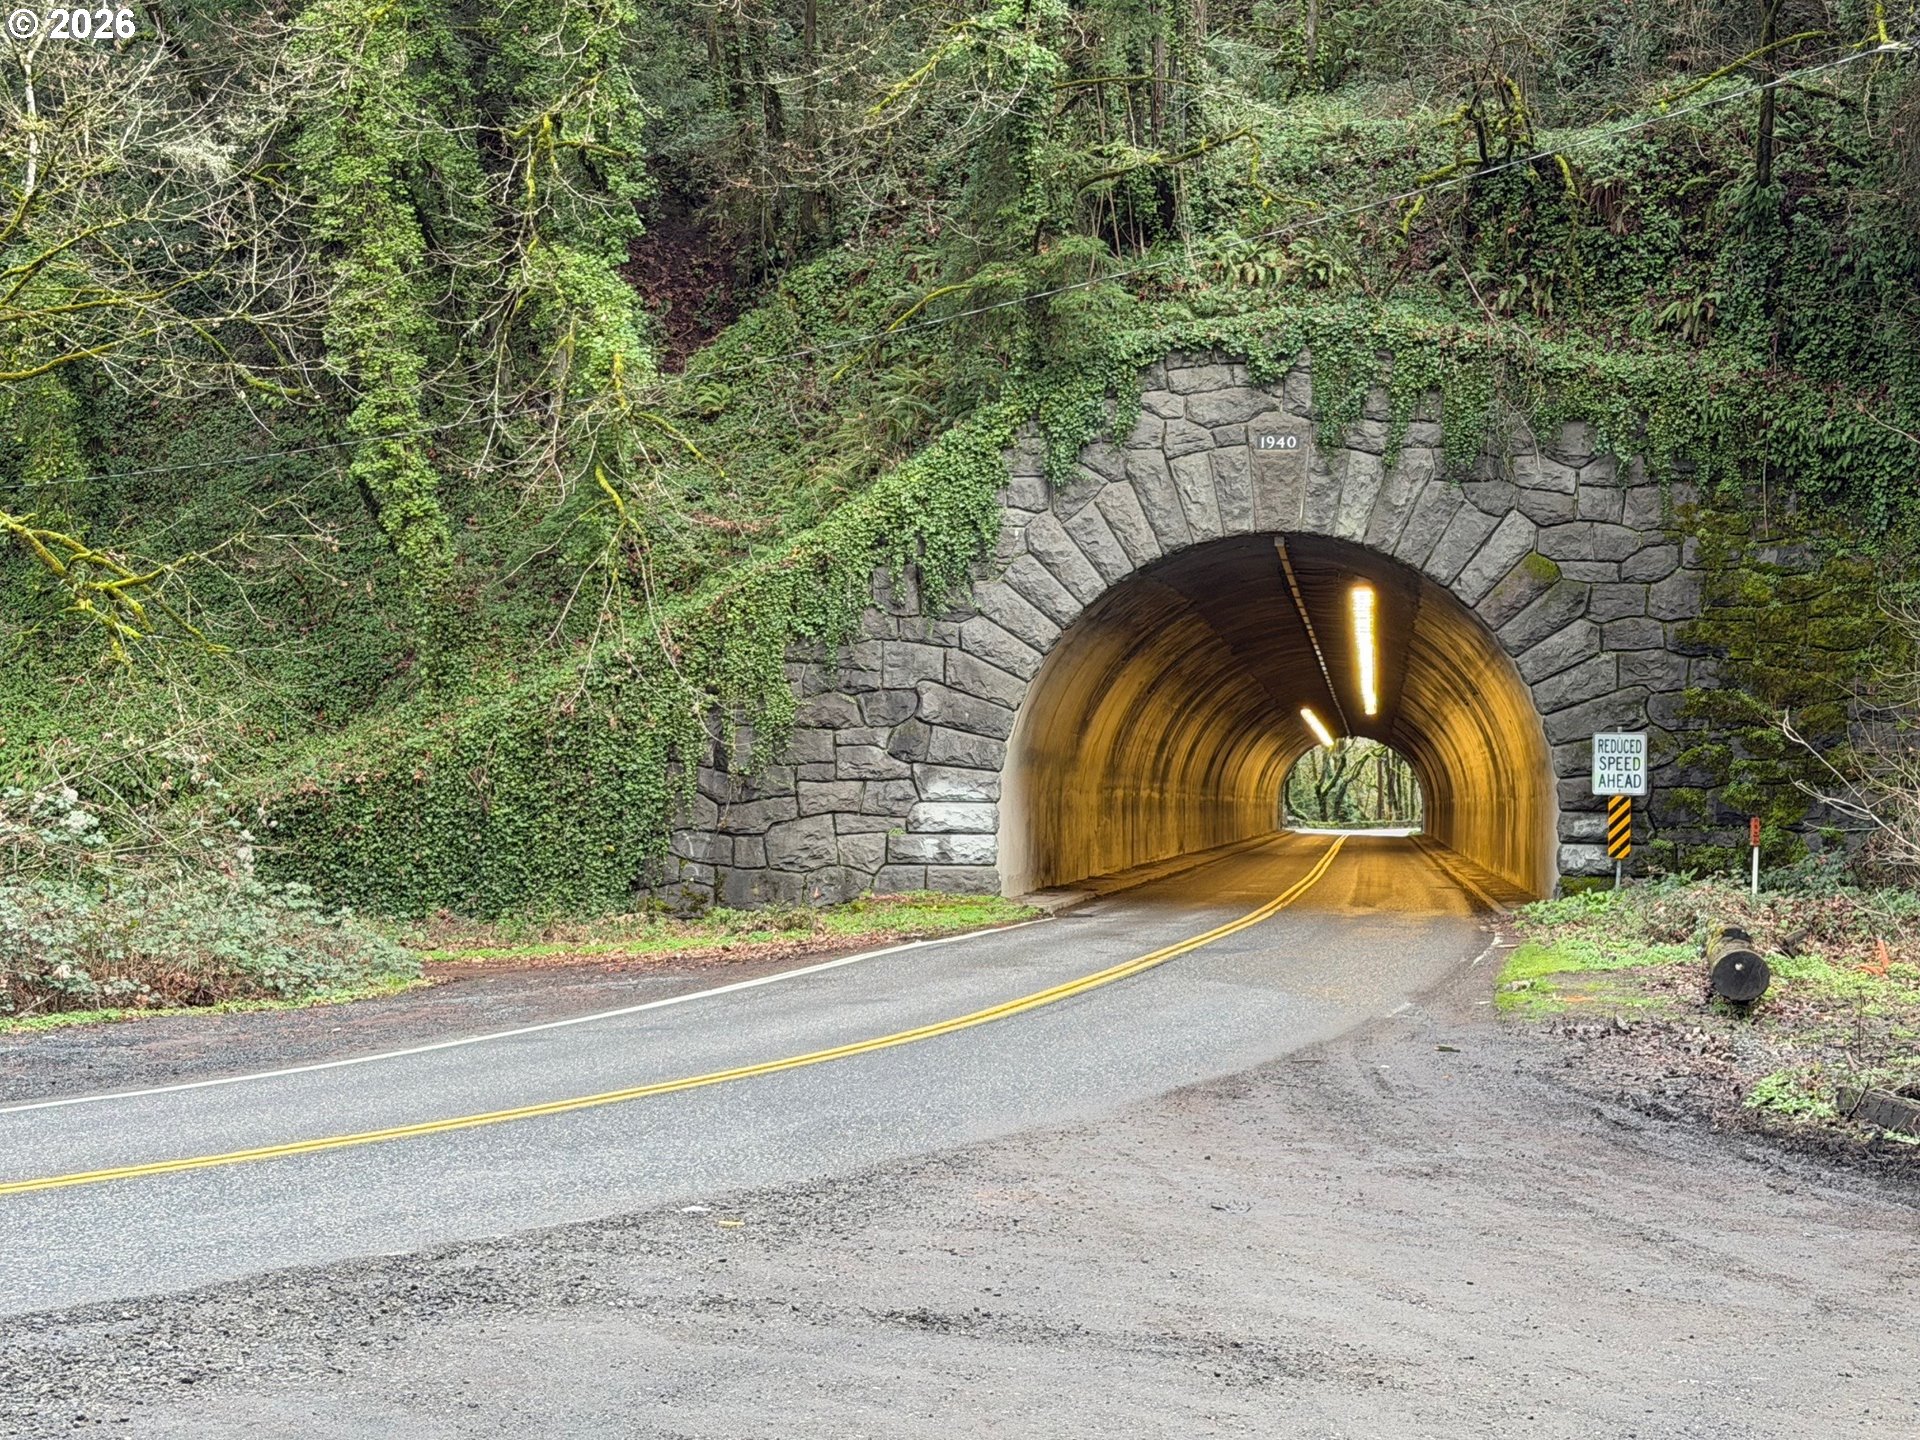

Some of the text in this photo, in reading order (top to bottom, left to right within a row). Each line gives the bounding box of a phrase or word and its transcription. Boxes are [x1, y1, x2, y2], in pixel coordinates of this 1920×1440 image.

[1260, 435, 1297, 449] 1940
[1597, 738, 1642, 754] REDUCED
[1599, 756, 1641, 771] SPEED
[1598, 773, 1642, 788] AHEAD
